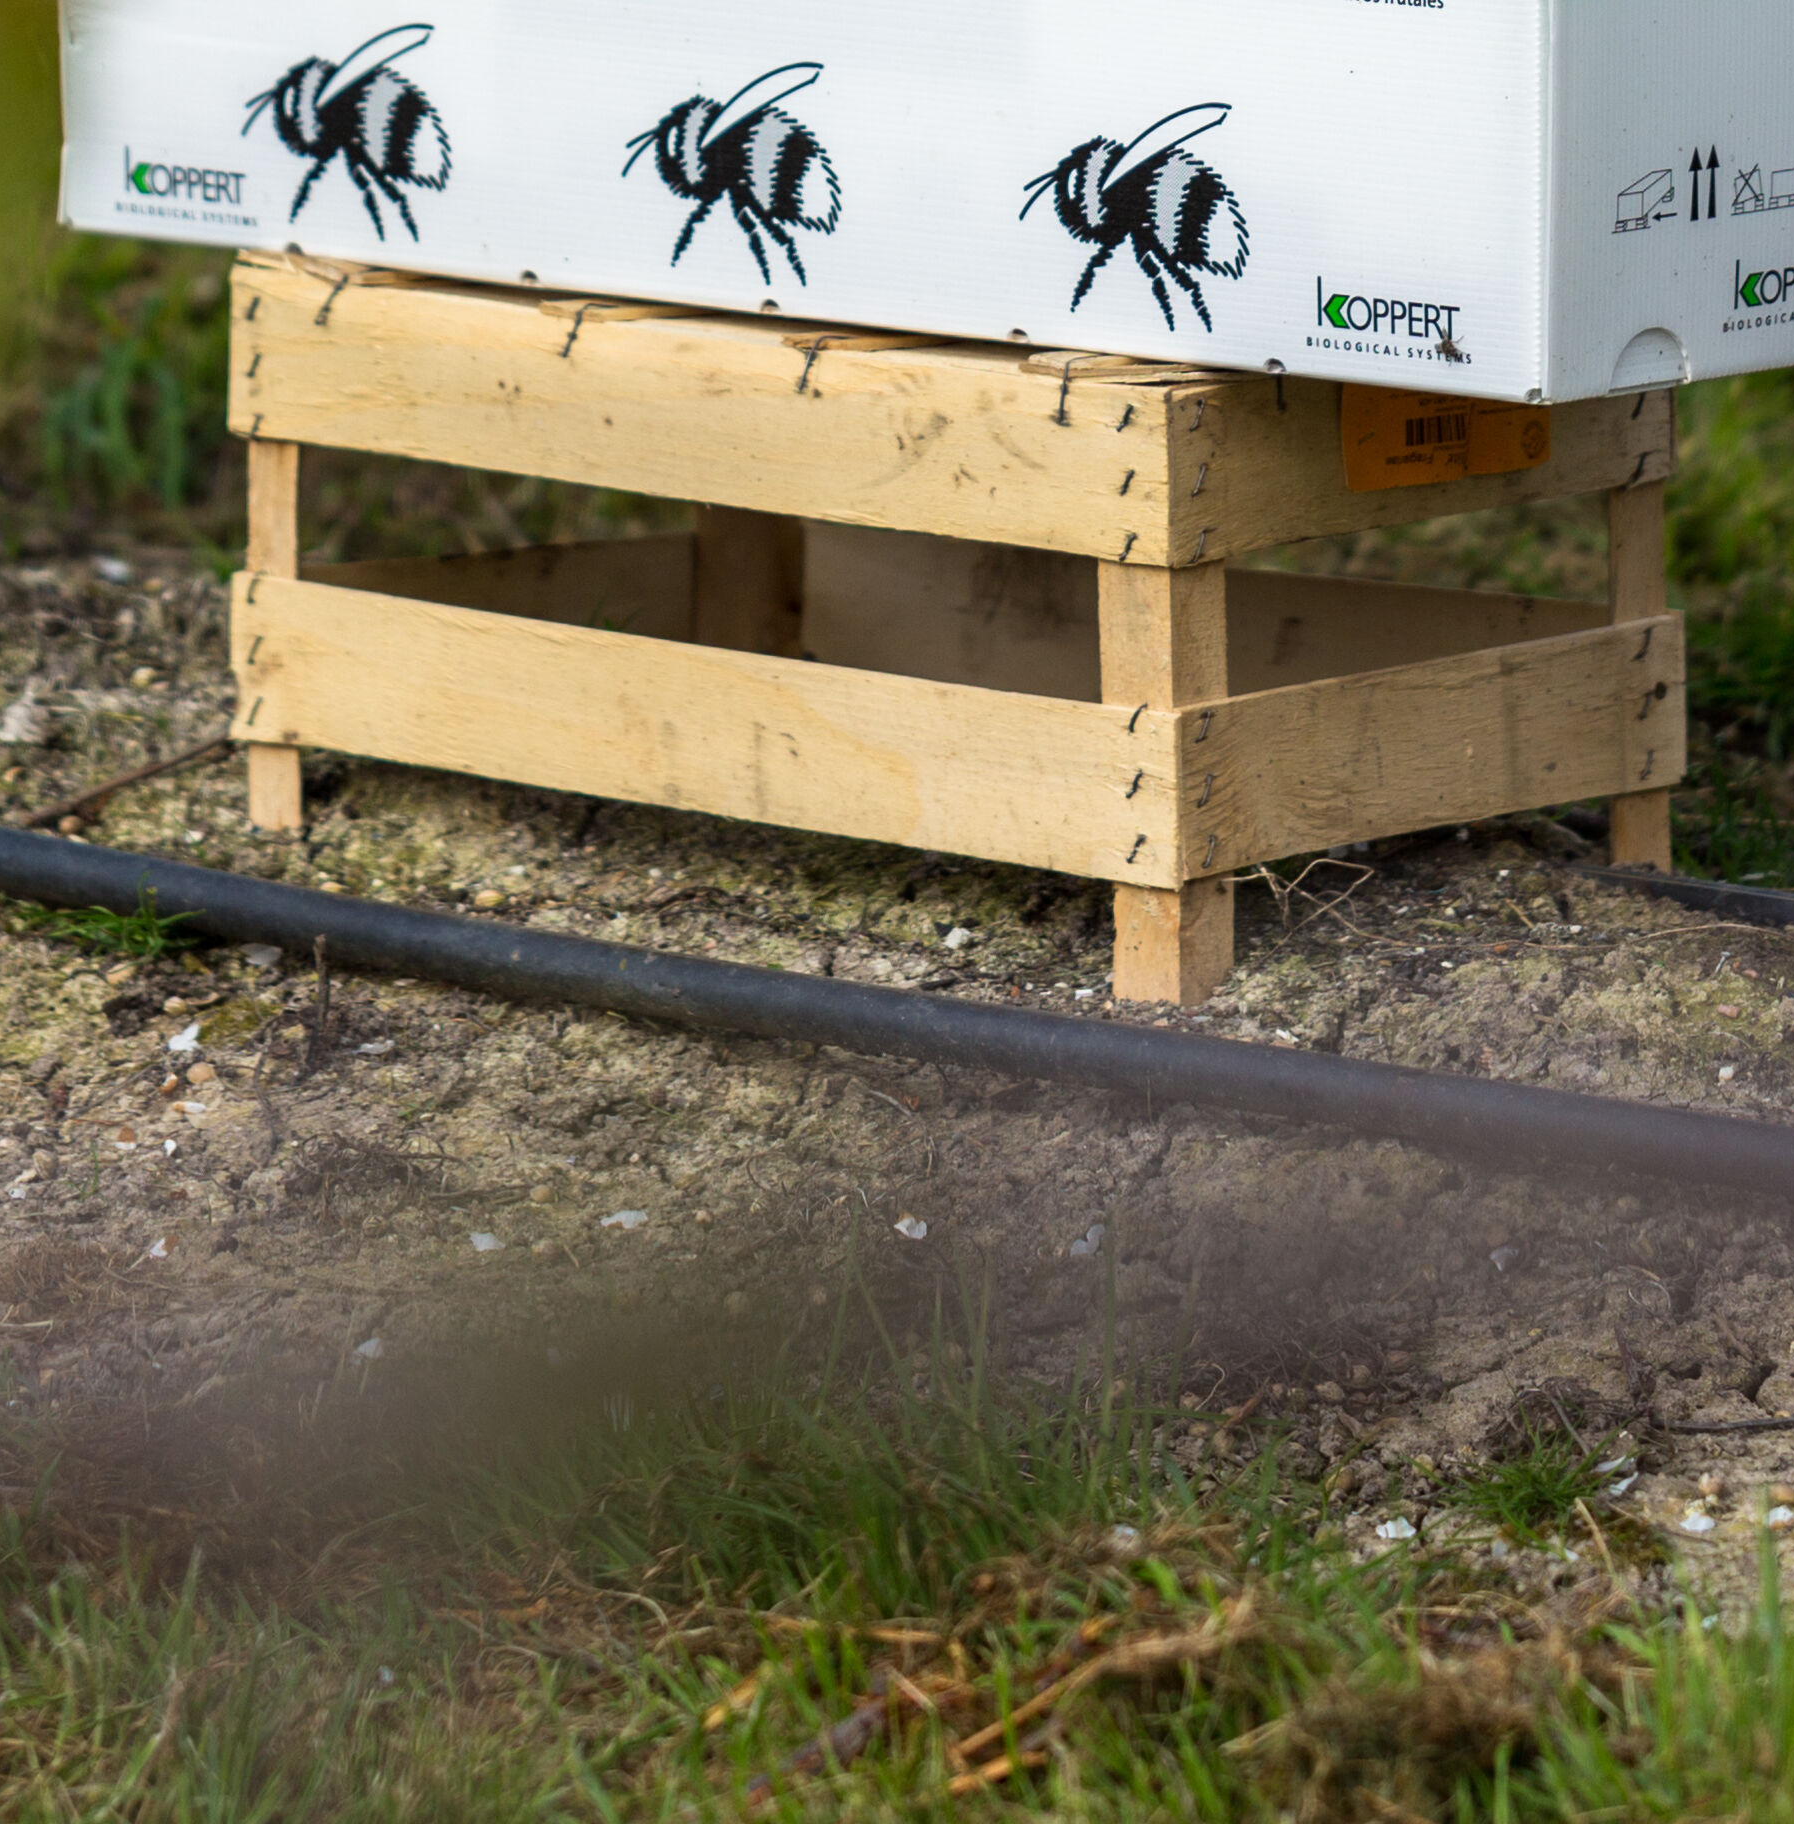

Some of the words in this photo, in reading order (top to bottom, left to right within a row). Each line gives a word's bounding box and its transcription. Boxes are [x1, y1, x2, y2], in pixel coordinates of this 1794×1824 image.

[115, 201, 198, 221] BIOLOGICAL
[202, 210, 258, 228] SYSTEMS
[1306, 336, 1400, 357] BIOLOGICAL
